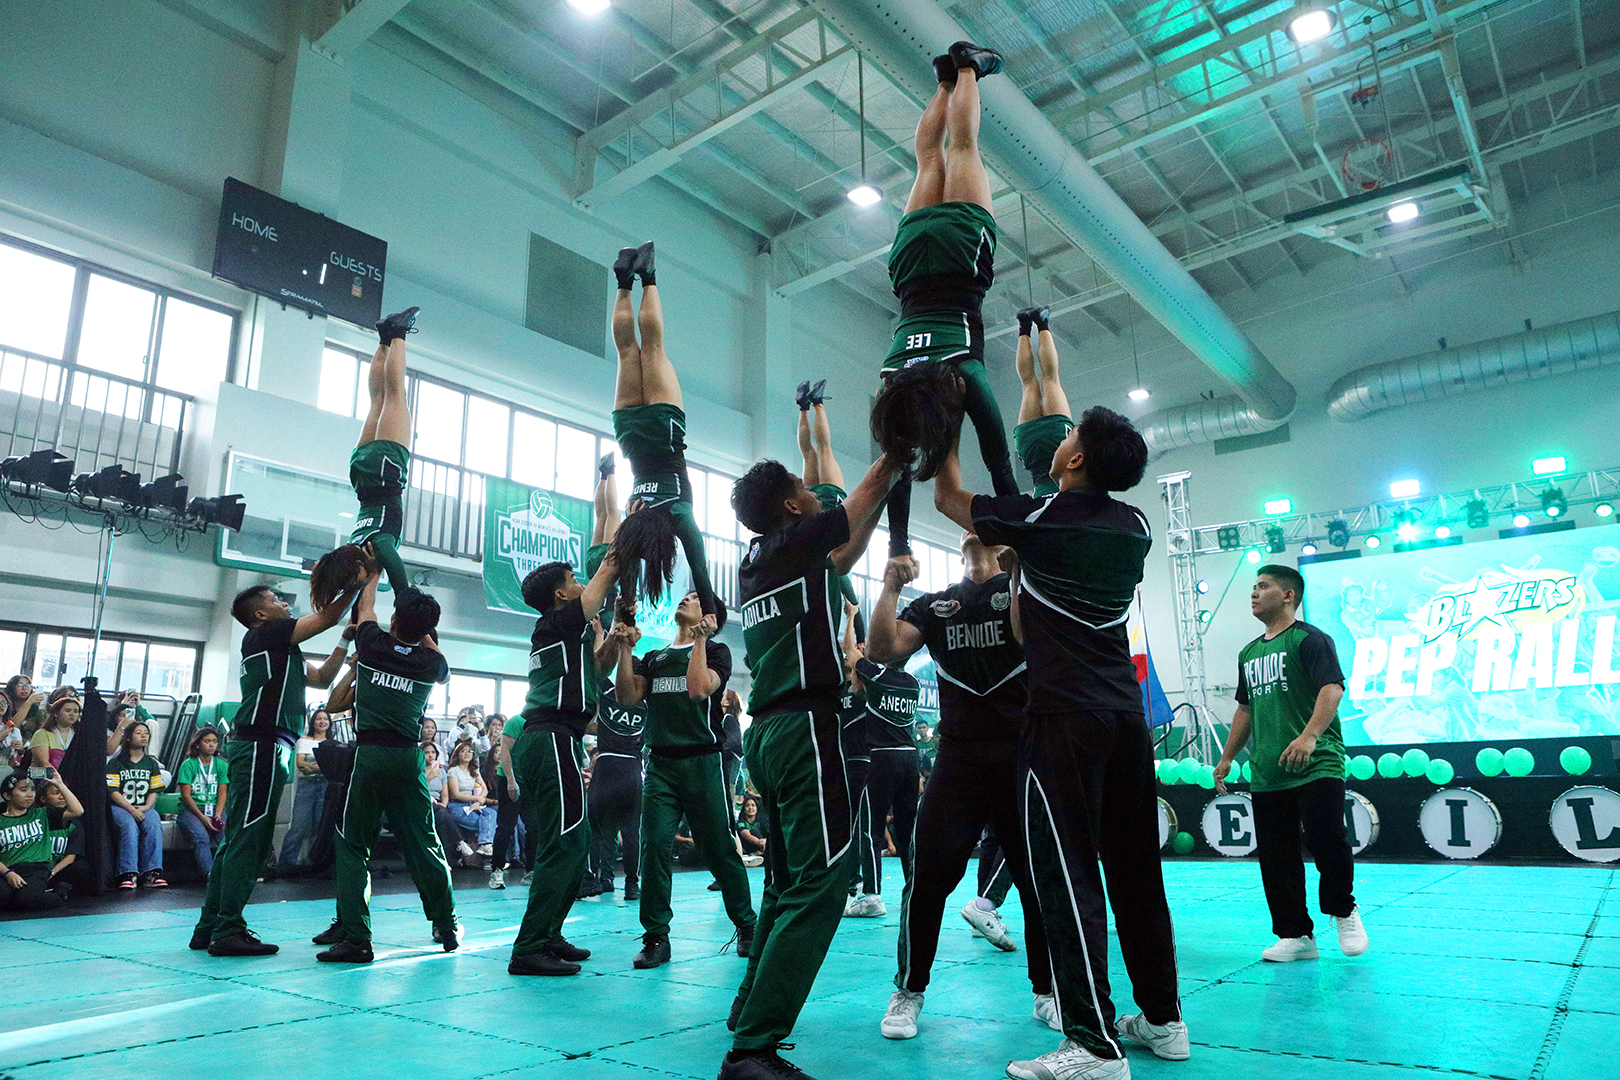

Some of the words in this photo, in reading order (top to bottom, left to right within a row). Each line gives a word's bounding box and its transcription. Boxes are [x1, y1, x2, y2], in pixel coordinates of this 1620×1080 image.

[231, 212, 279, 243] HOME
[329, 251, 382, 282] GUESTS
[905, 332, 932, 350] LEE
[500, 519, 579, 569] CHAMPIONS
[945, 620, 1006, 651] BENILDE
[1349, 632, 1458, 701] PEP
[370, 671, 414, 695] PALOMA
[652, 676, 688, 694] BENILD
[608, 706, 642, 727] YAP
[878, 695, 917, 715] ANECITO
[122, 780, 150, 805] 82
